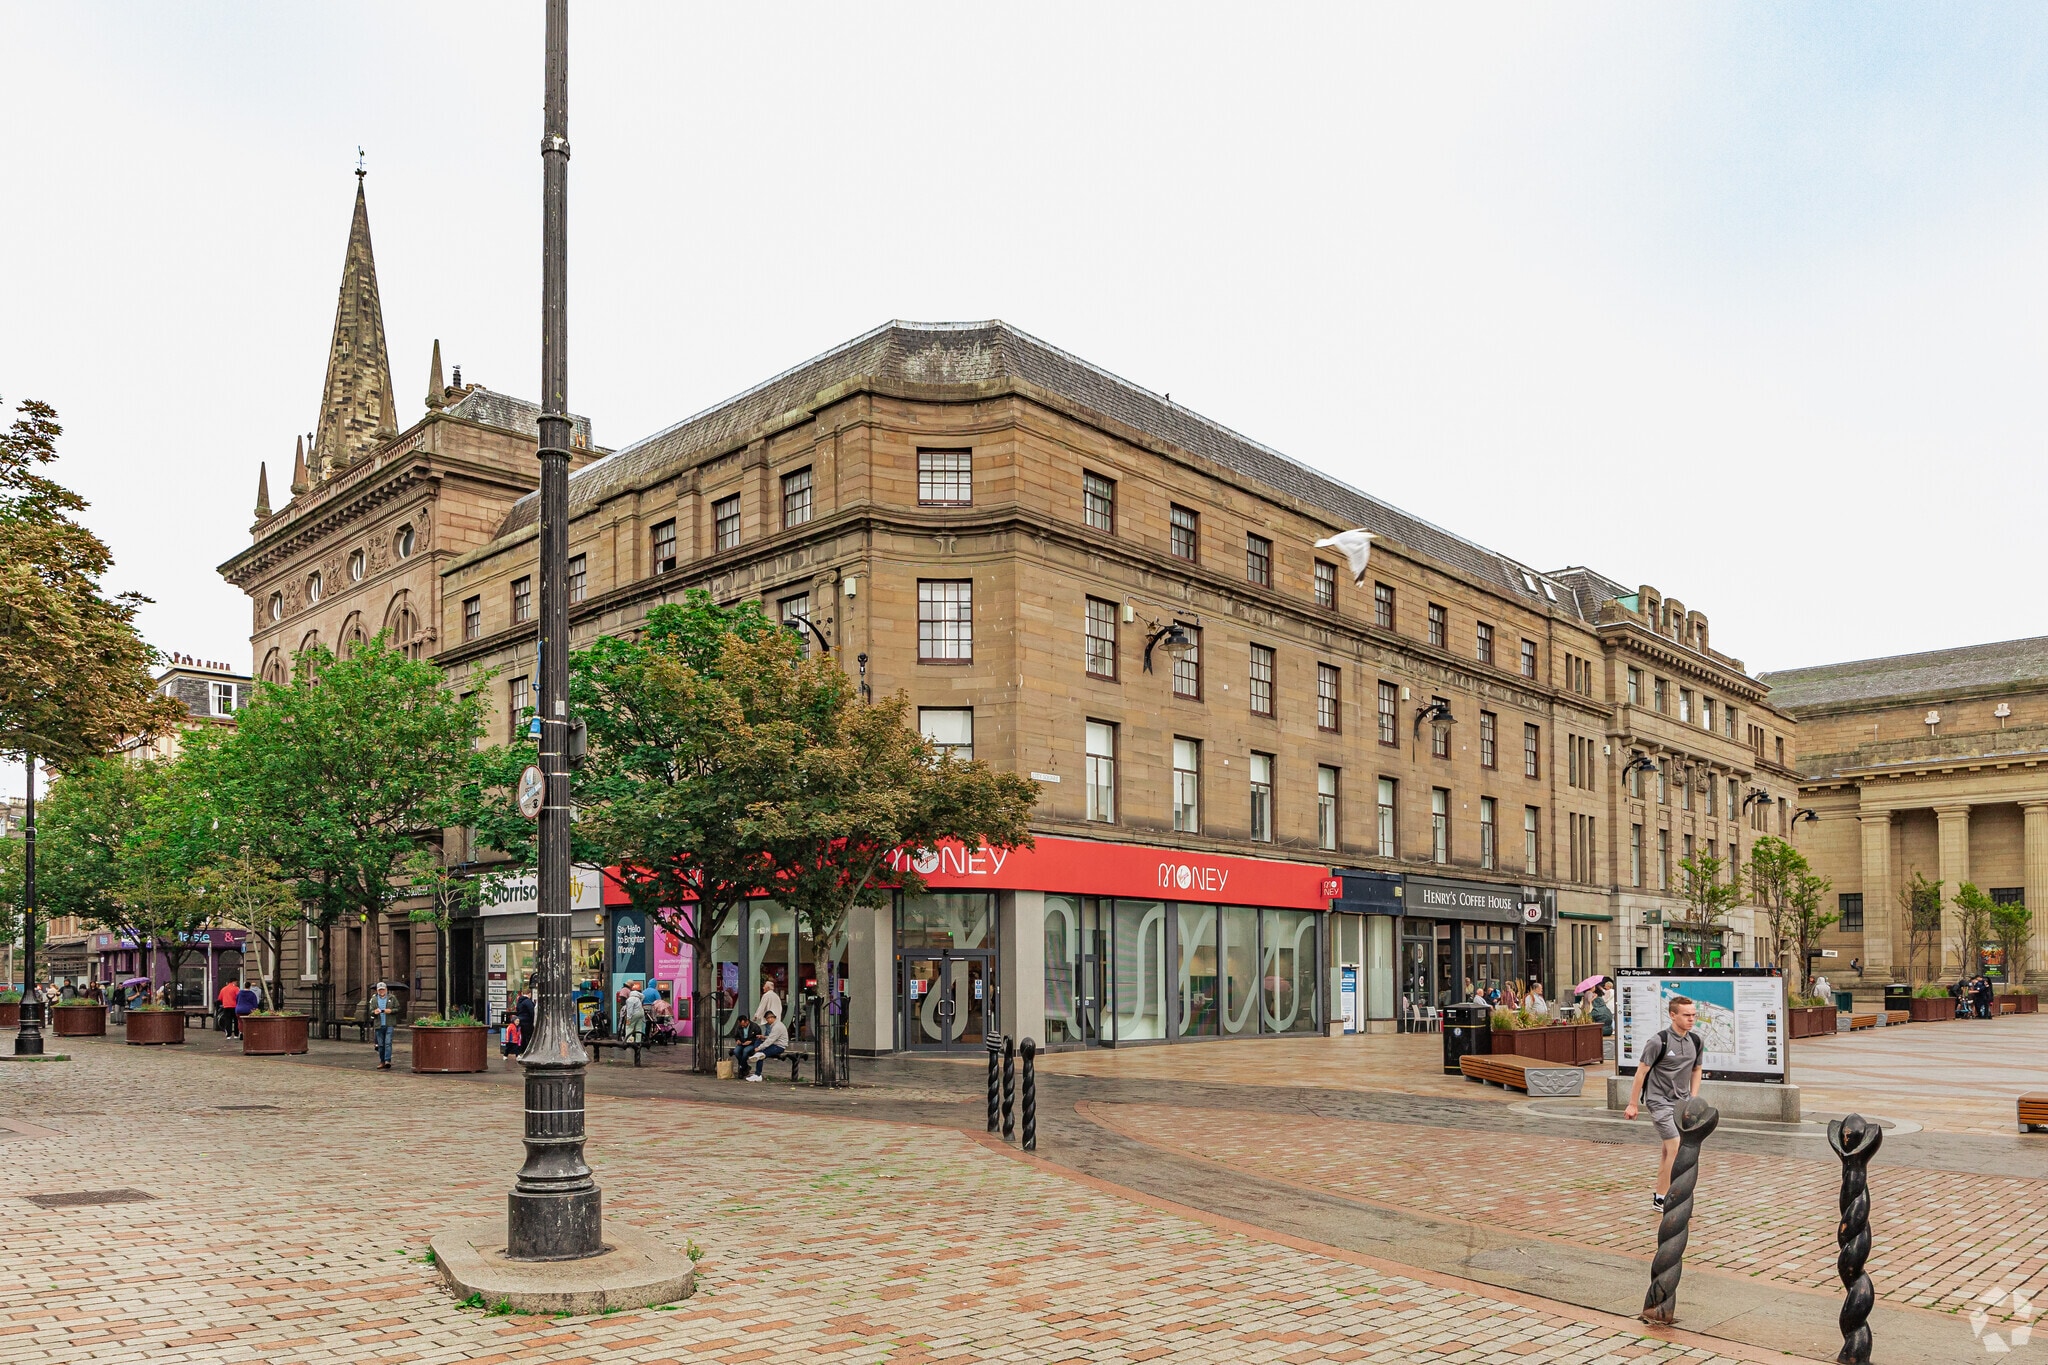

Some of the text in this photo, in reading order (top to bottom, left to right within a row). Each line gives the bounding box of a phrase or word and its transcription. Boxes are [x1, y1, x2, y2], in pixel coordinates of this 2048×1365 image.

[883, 846, 1008, 875] MONEY
[1158, 862, 1229, 892] MONEY
[492, 874, 584, 904] Morriso ily
[1323, 888, 1340, 896] NEY
[1423, 889, 1512, 910] HENRY'S COFFEE HOUSE
[617, 924, 641, 934] Say Hello
[224, 931, 235, 943] &
[617, 935, 646, 945] to Brighter
[617, 946, 635, 955] Money
